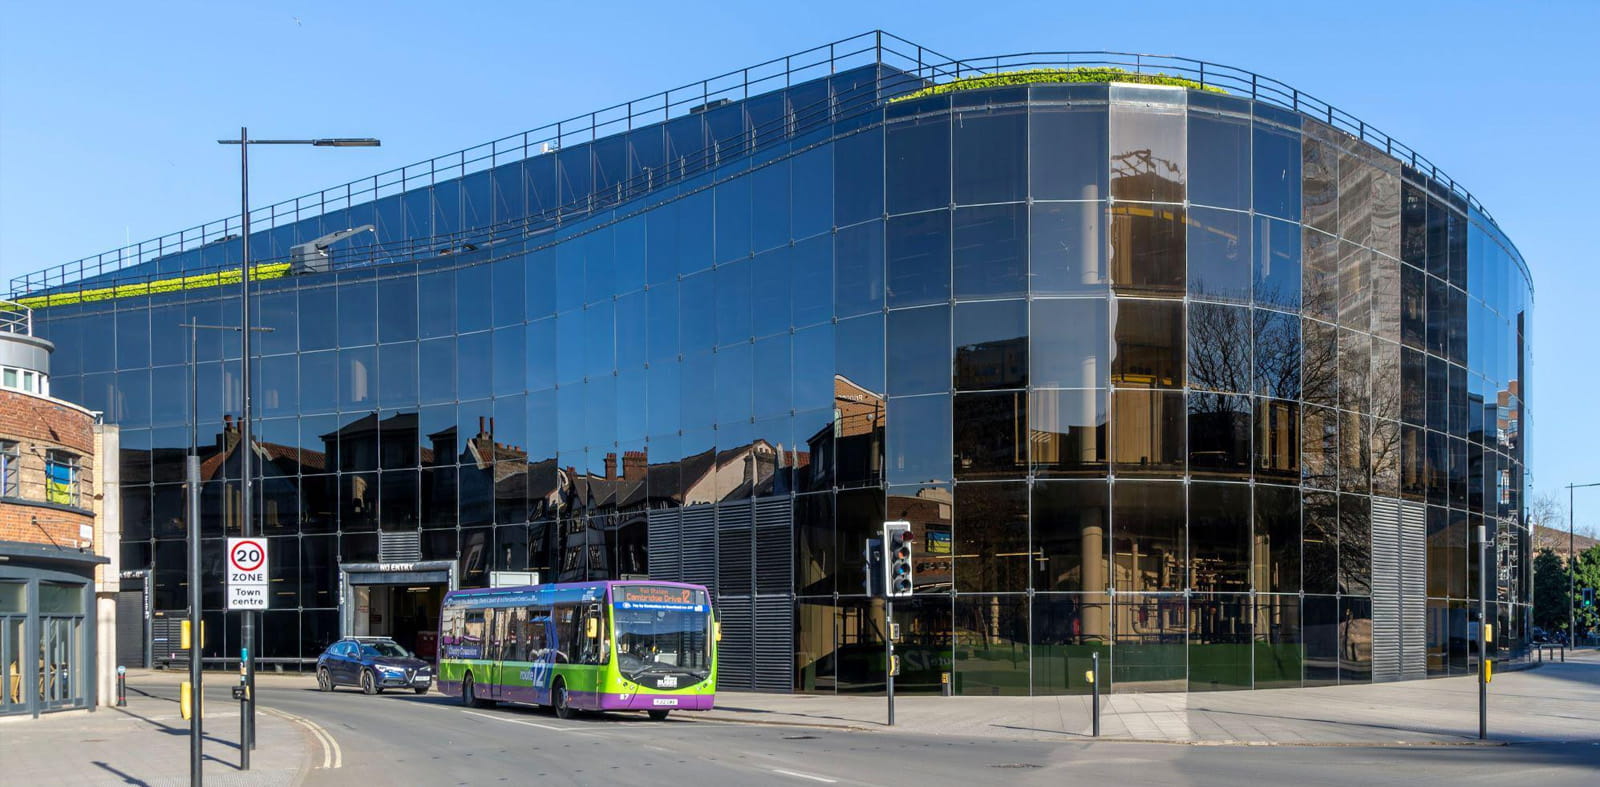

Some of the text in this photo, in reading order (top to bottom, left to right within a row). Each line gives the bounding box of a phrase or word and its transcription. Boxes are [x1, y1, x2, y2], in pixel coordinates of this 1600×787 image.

[237, 550, 260, 562] 20
[380, 563, 415, 571] NO ENTRY
[232, 573, 263, 582] ZONE
[235, 588, 261, 596] Town
[682, 589, 691, 604] 12
[232, 597, 264, 606] centre
[626, 593, 682, 604] Cambridge Drive
[519, 659, 546, 687] route 12
